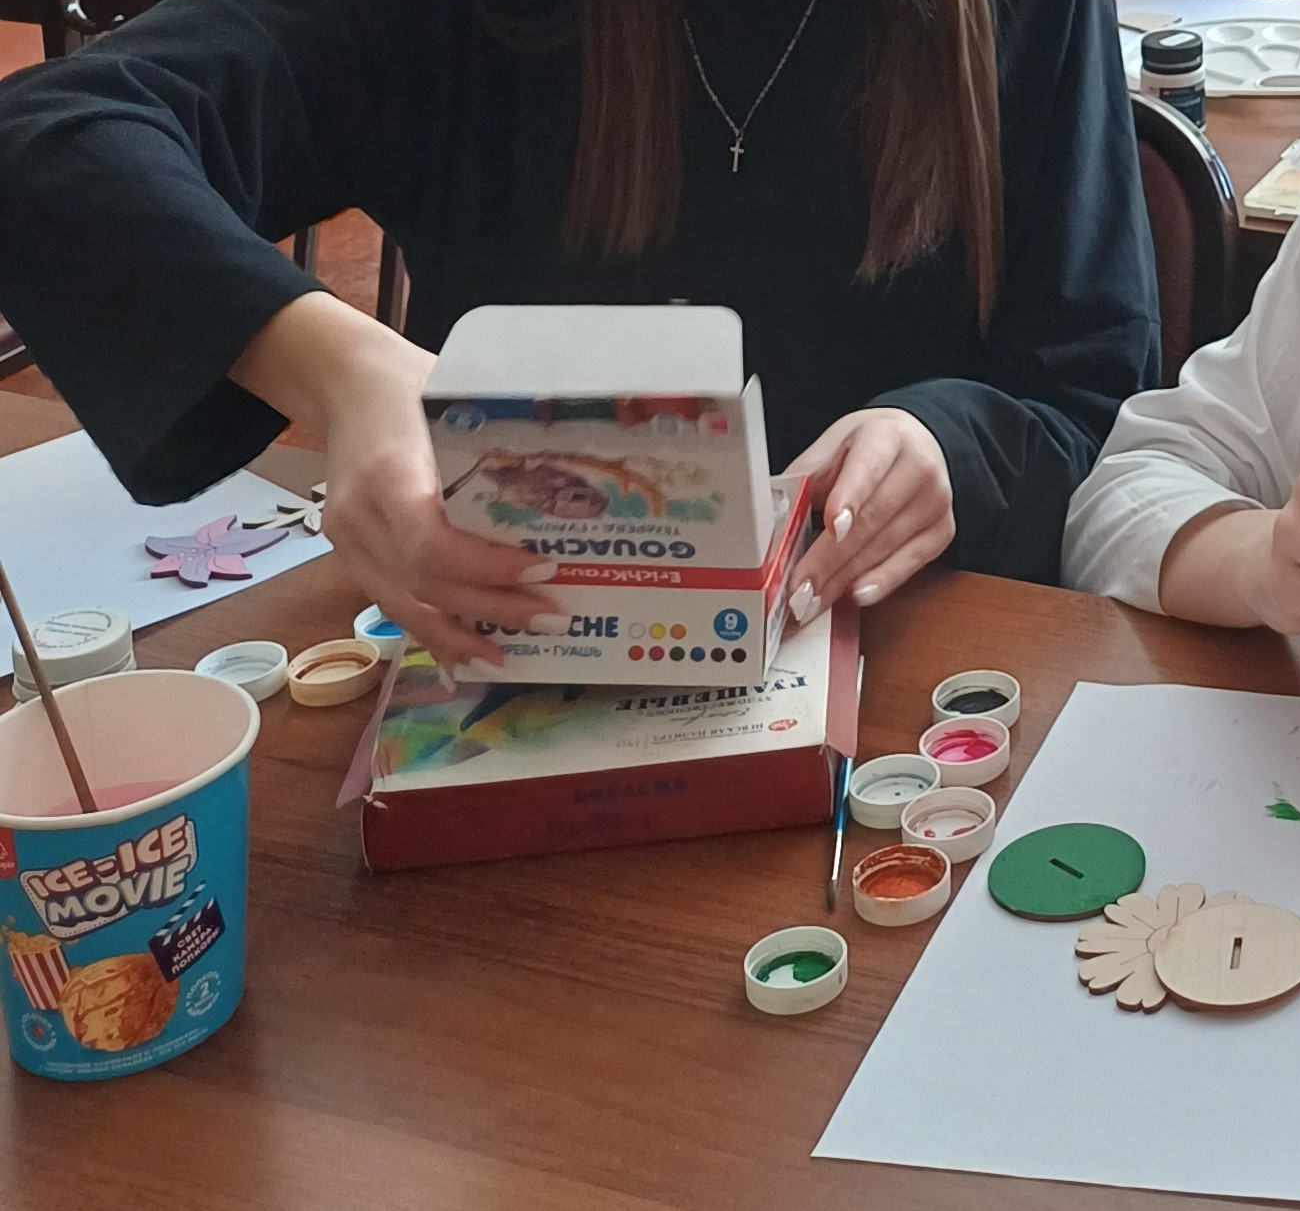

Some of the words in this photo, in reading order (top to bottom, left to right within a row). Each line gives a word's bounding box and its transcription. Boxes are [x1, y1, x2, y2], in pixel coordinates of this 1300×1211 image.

[558, 567, 682, 584] ErichKraus
[724, 612, 739, 631] 9
[47, 855, 190, 923] MOVIE
